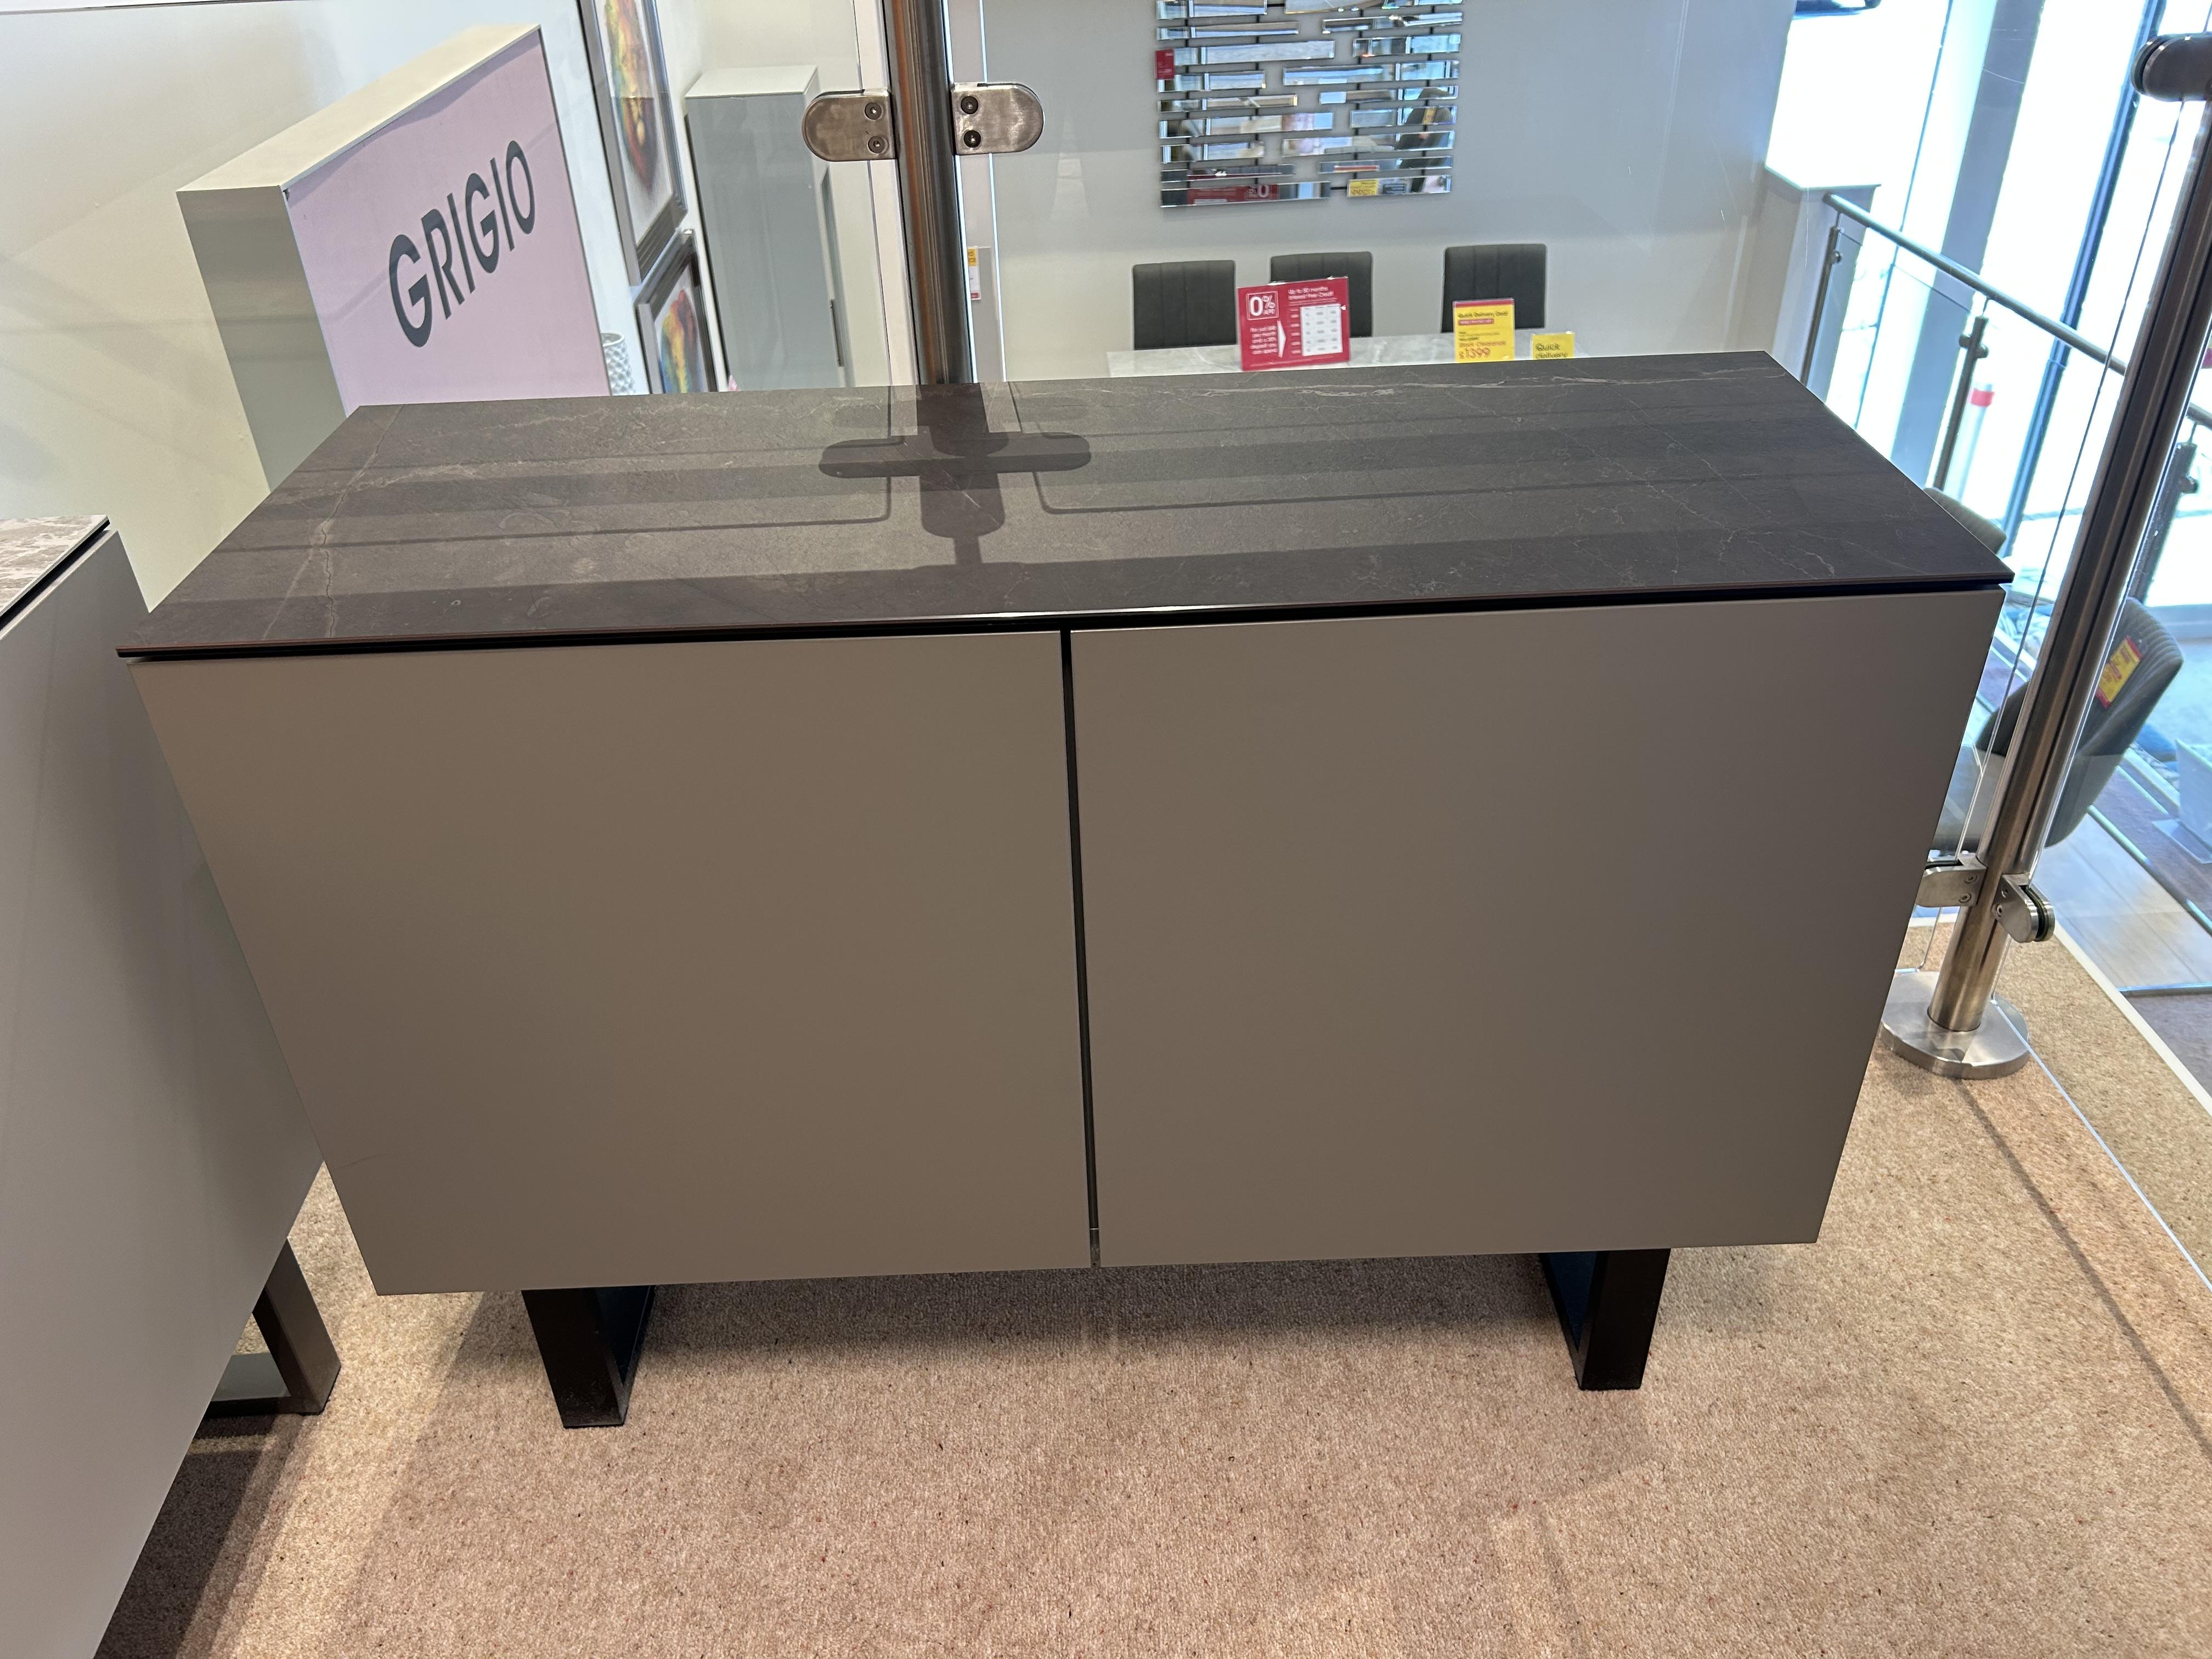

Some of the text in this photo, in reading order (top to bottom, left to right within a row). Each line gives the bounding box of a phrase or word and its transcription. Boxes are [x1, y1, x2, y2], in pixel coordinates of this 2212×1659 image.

[389, 140, 535, 347] GRIGIO
[1250, 295, 1276, 316] 0%
[1536, 343, 1560, 351] Quick
